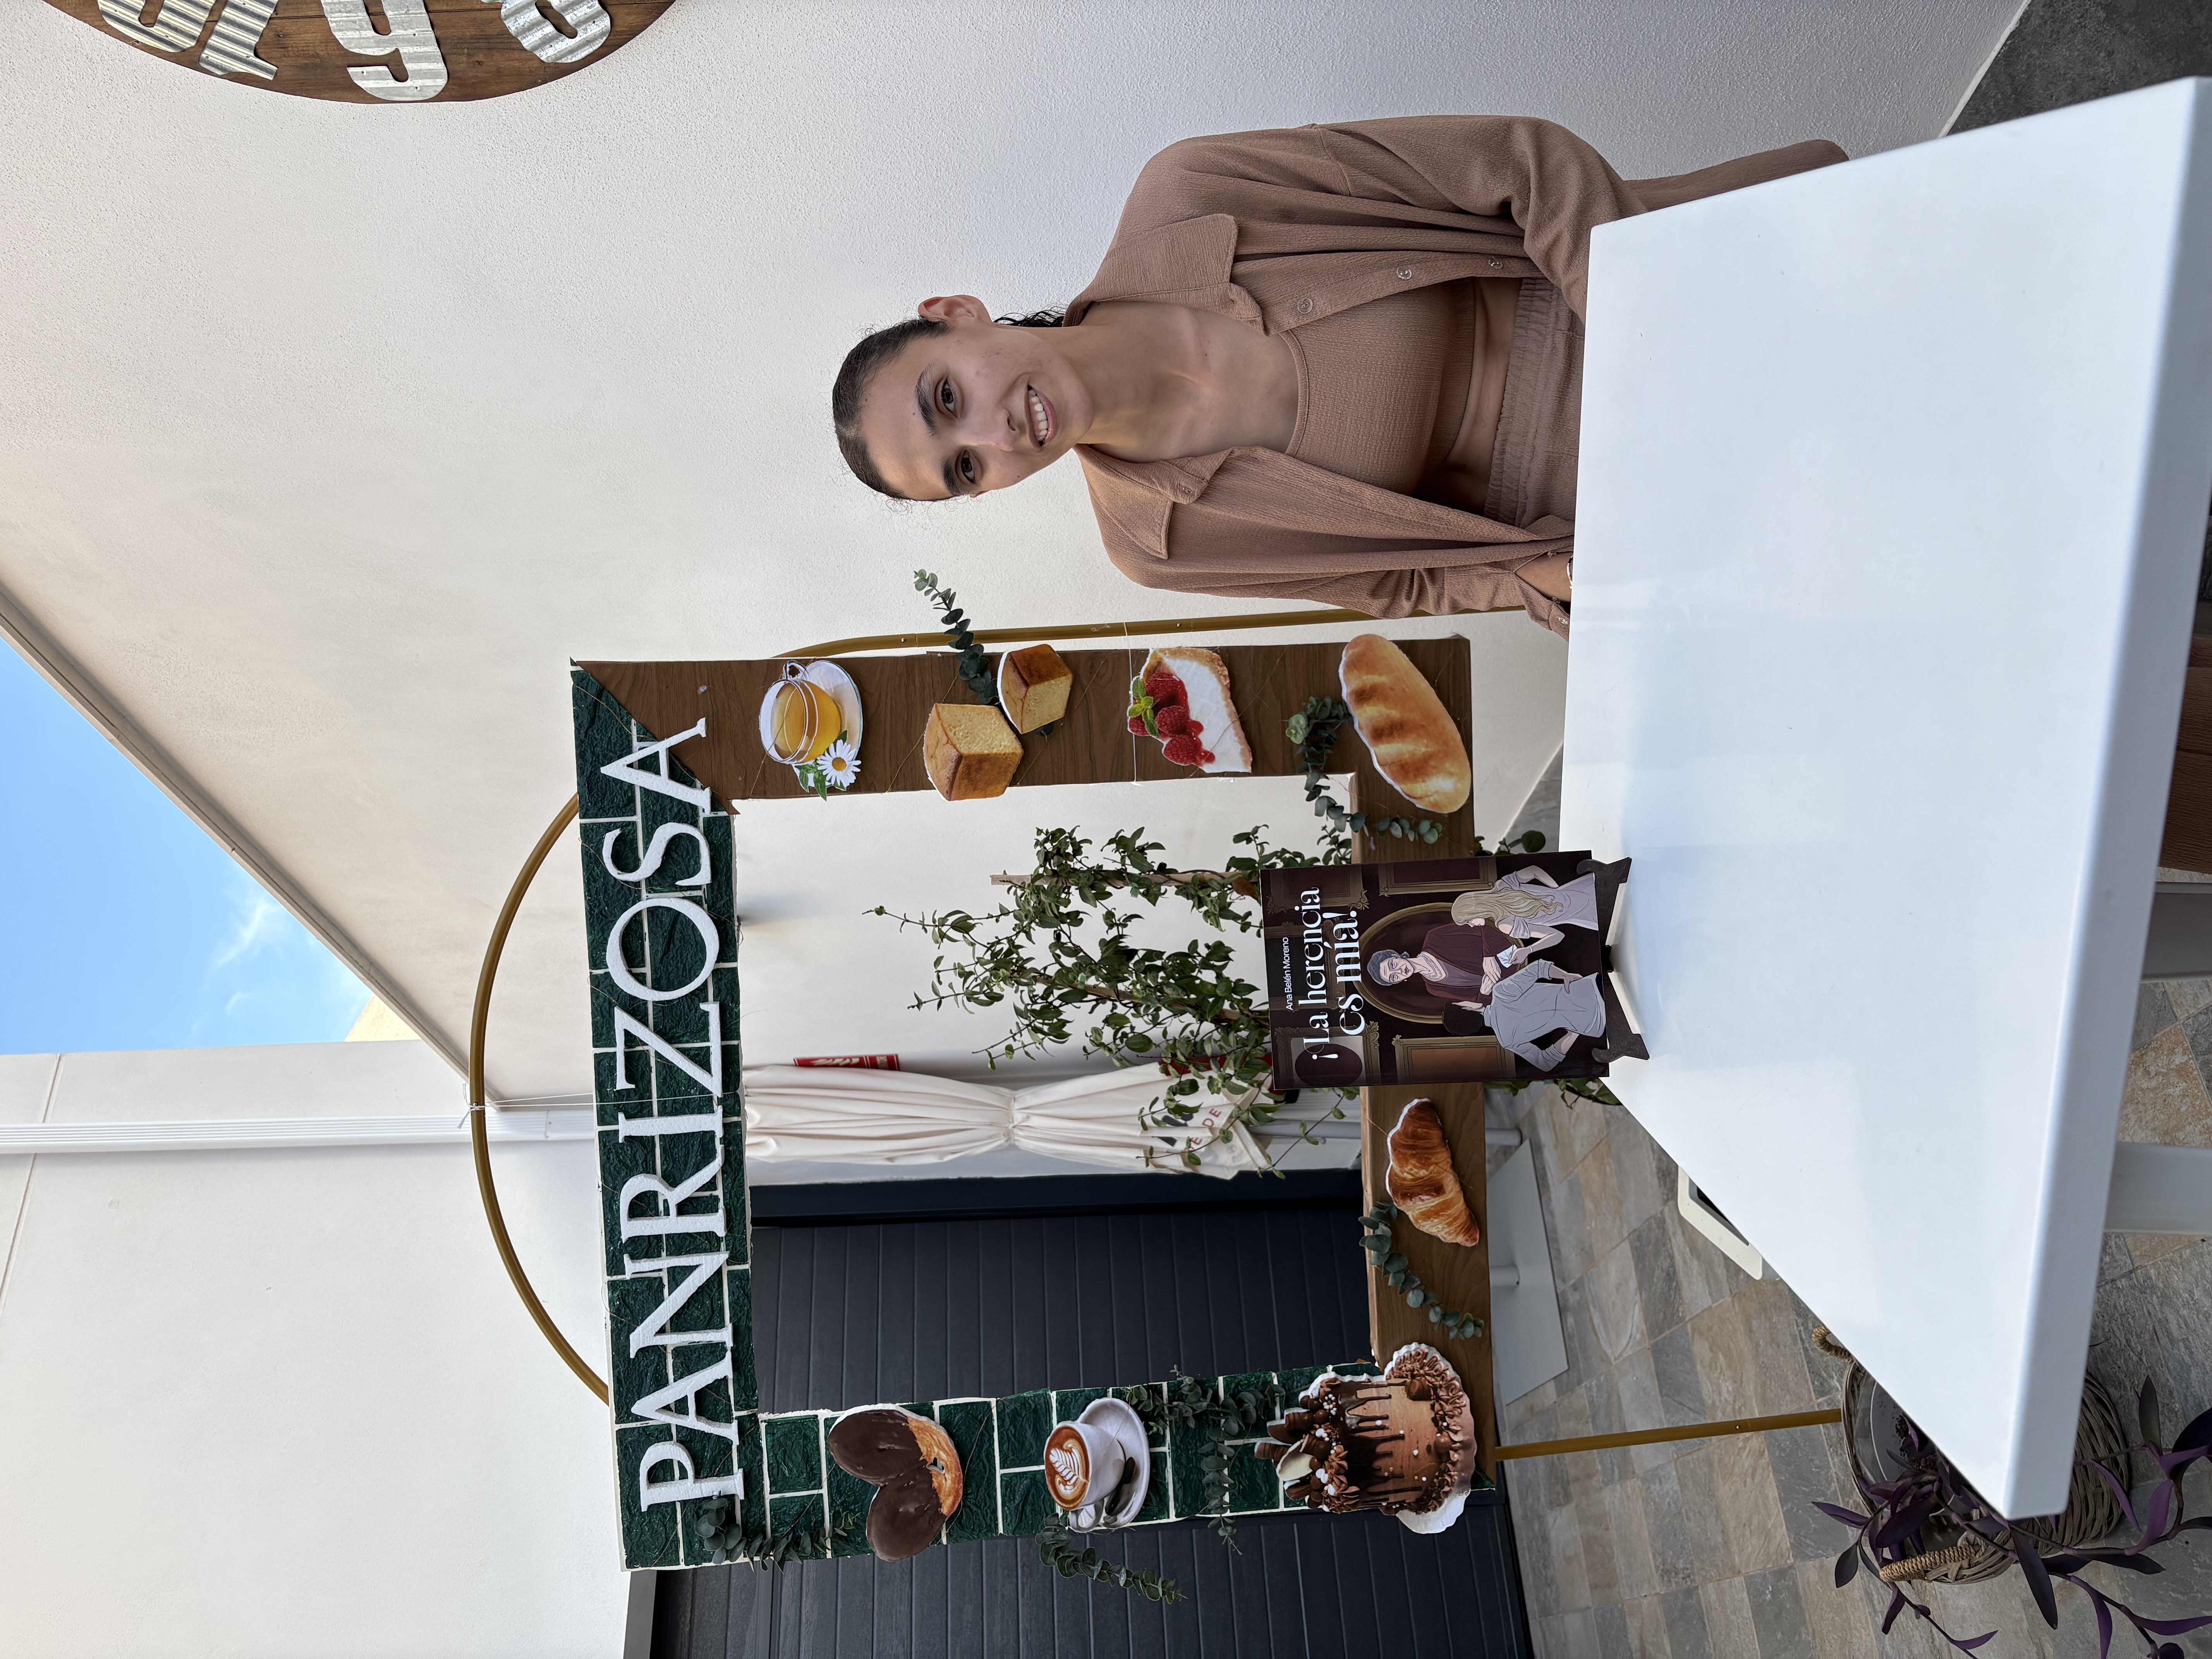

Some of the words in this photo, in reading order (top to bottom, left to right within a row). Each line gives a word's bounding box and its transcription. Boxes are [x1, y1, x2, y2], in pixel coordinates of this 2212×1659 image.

[1282, 937, 1290, 969] Moreno
[1294, 887, 1327, 1005] herencia
[1322, 910, 1362, 984] mía!
[1283, 970, 1292, 993] Belén
[1303, 1012, 1338, 1060] ¡La
[1335, 994, 1365, 1035] es
[600, 716, 745, 1514] PANRIZOSA
